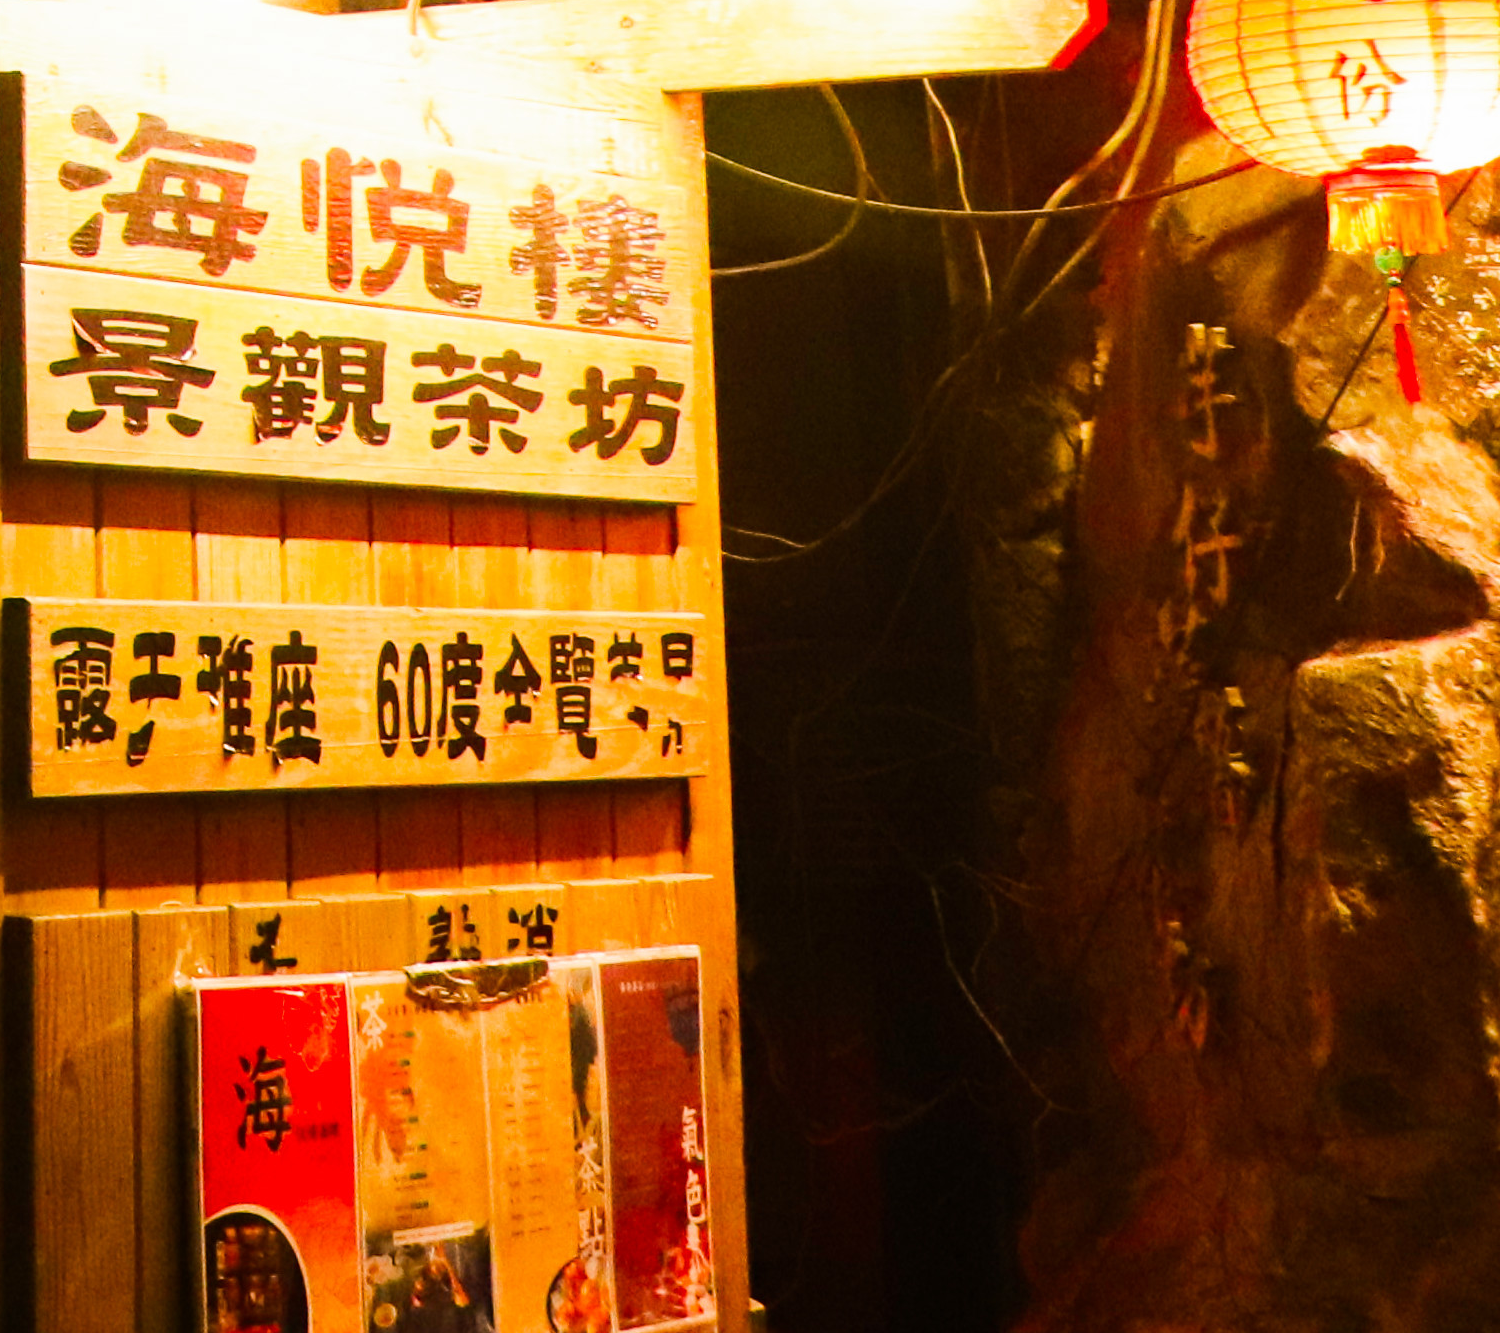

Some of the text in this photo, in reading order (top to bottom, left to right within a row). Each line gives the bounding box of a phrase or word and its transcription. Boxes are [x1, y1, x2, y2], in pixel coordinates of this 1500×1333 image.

[49, 307, 686, 467] 景觀茶坊
[234, 1045, 293, 1153] 海
